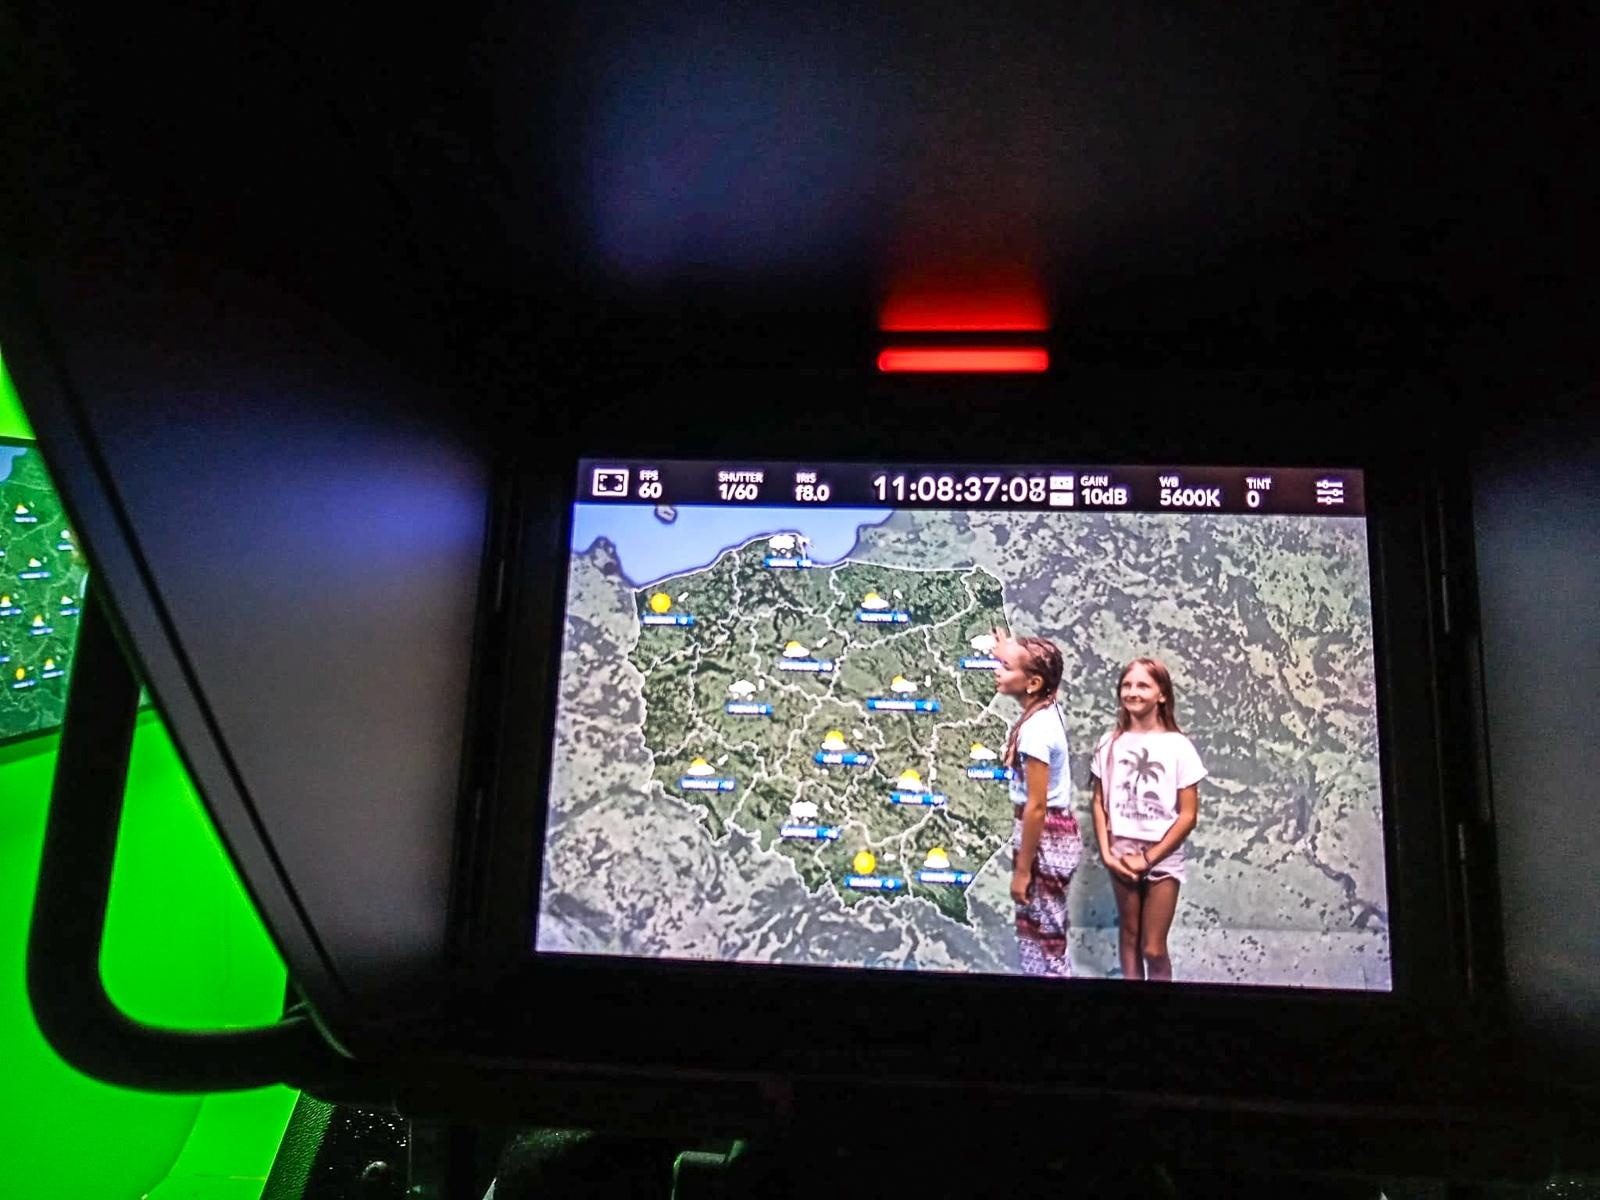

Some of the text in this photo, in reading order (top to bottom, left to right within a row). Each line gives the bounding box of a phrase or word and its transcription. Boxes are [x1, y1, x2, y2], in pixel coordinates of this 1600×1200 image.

[639, 470, 659, 482] FPS
[718, 471, 764, 483] SHUTTER
[796, 473, 817, 484] IRIS
[1080, 475, 1108, 487] GAIN
[1159, 476, 1179, 488] WB
[1246, 477, 1271, 490] TINT
[638, 482, 663, 499] 60
[719, 484, 758, 501] 1/60
[795, 484, 830, 502] f8.0
[873, 475, 1046, 502] 11:08:37:08
[1081, 488, 1128, 506] 10dB
[1160, 488, 1221, 507] 5600K
[1247, 490, 1260, 508] 0
